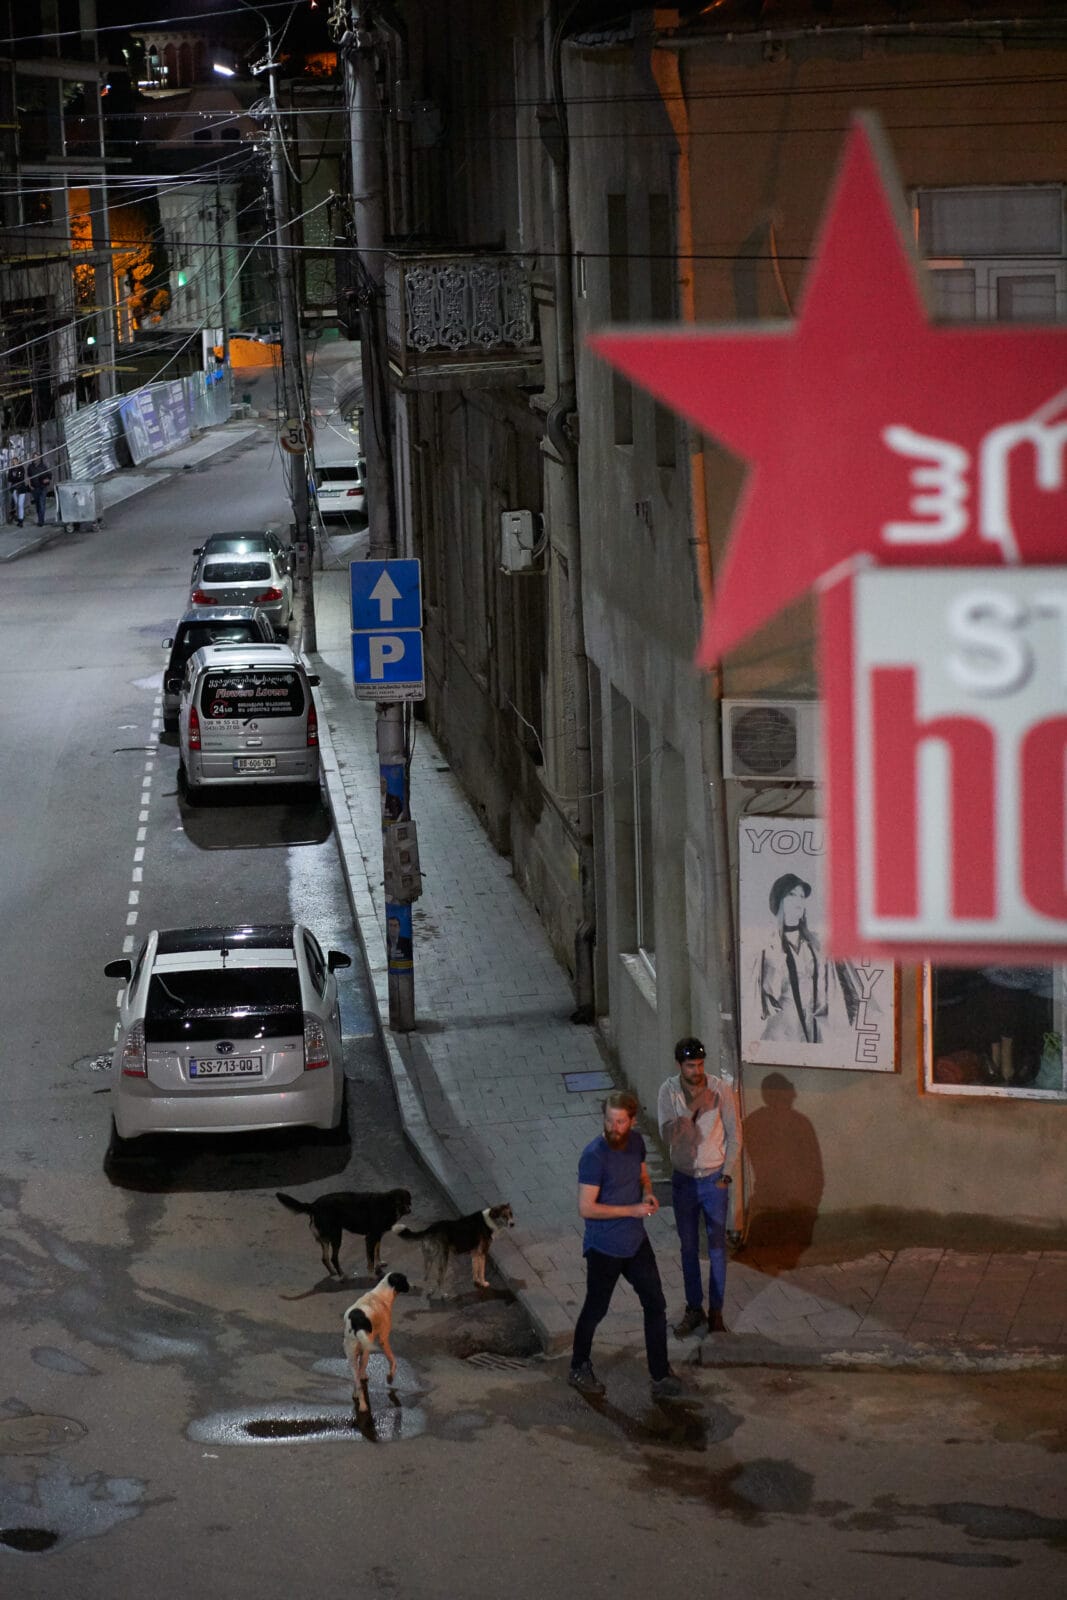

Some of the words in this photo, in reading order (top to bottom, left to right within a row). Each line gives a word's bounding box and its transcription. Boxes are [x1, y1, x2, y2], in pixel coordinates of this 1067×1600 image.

[289, 428, 307, 445] 50
[369, 635, 406, 680] P
[855, 955, 885, 1064] YLE
[199, 1059, 254, 1073] SS-713-QQ
